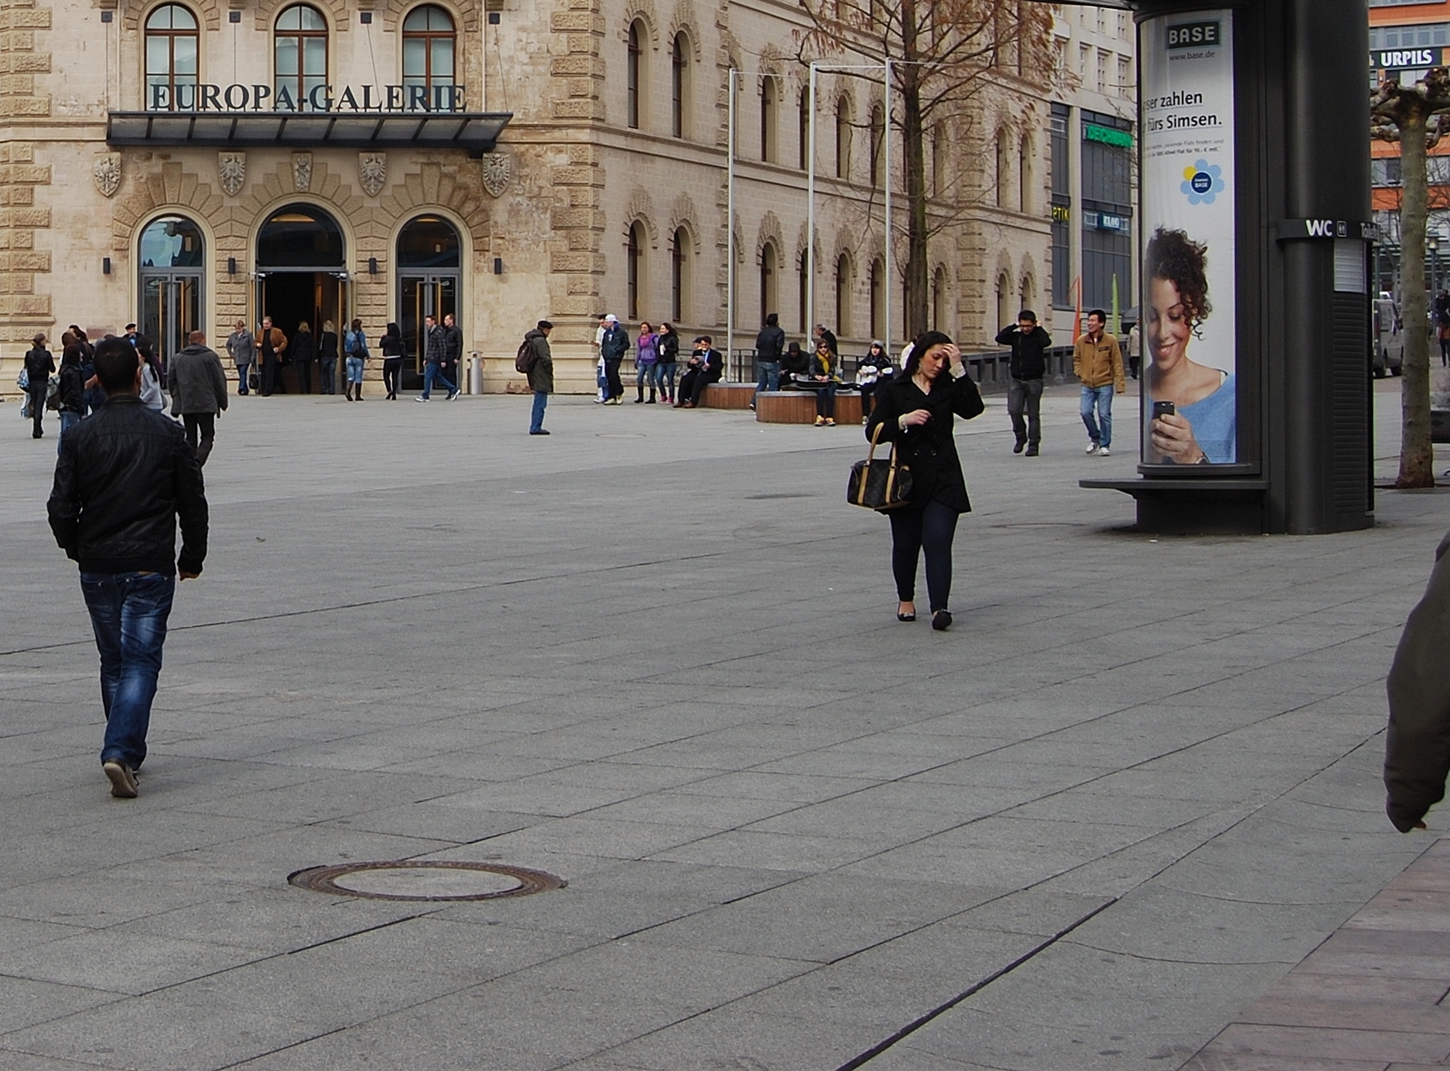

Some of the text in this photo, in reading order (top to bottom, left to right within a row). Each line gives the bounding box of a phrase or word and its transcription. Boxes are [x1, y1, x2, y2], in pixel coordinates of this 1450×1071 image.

[1169, 26, 1215, 44] BASE
[1169, 51, 1215, 61] www.base.de
[1380, 49, 1433, 67] URPILS
[150, 84, 467, 111] EUROPA-GALERIE
[1160, 90, 1203, 108] zahlen
[1166, 114, 1222, 129] Simsen.
[1052, 206, 1069, 221] PTIK
[1306, 219, 1332, 237] WC
